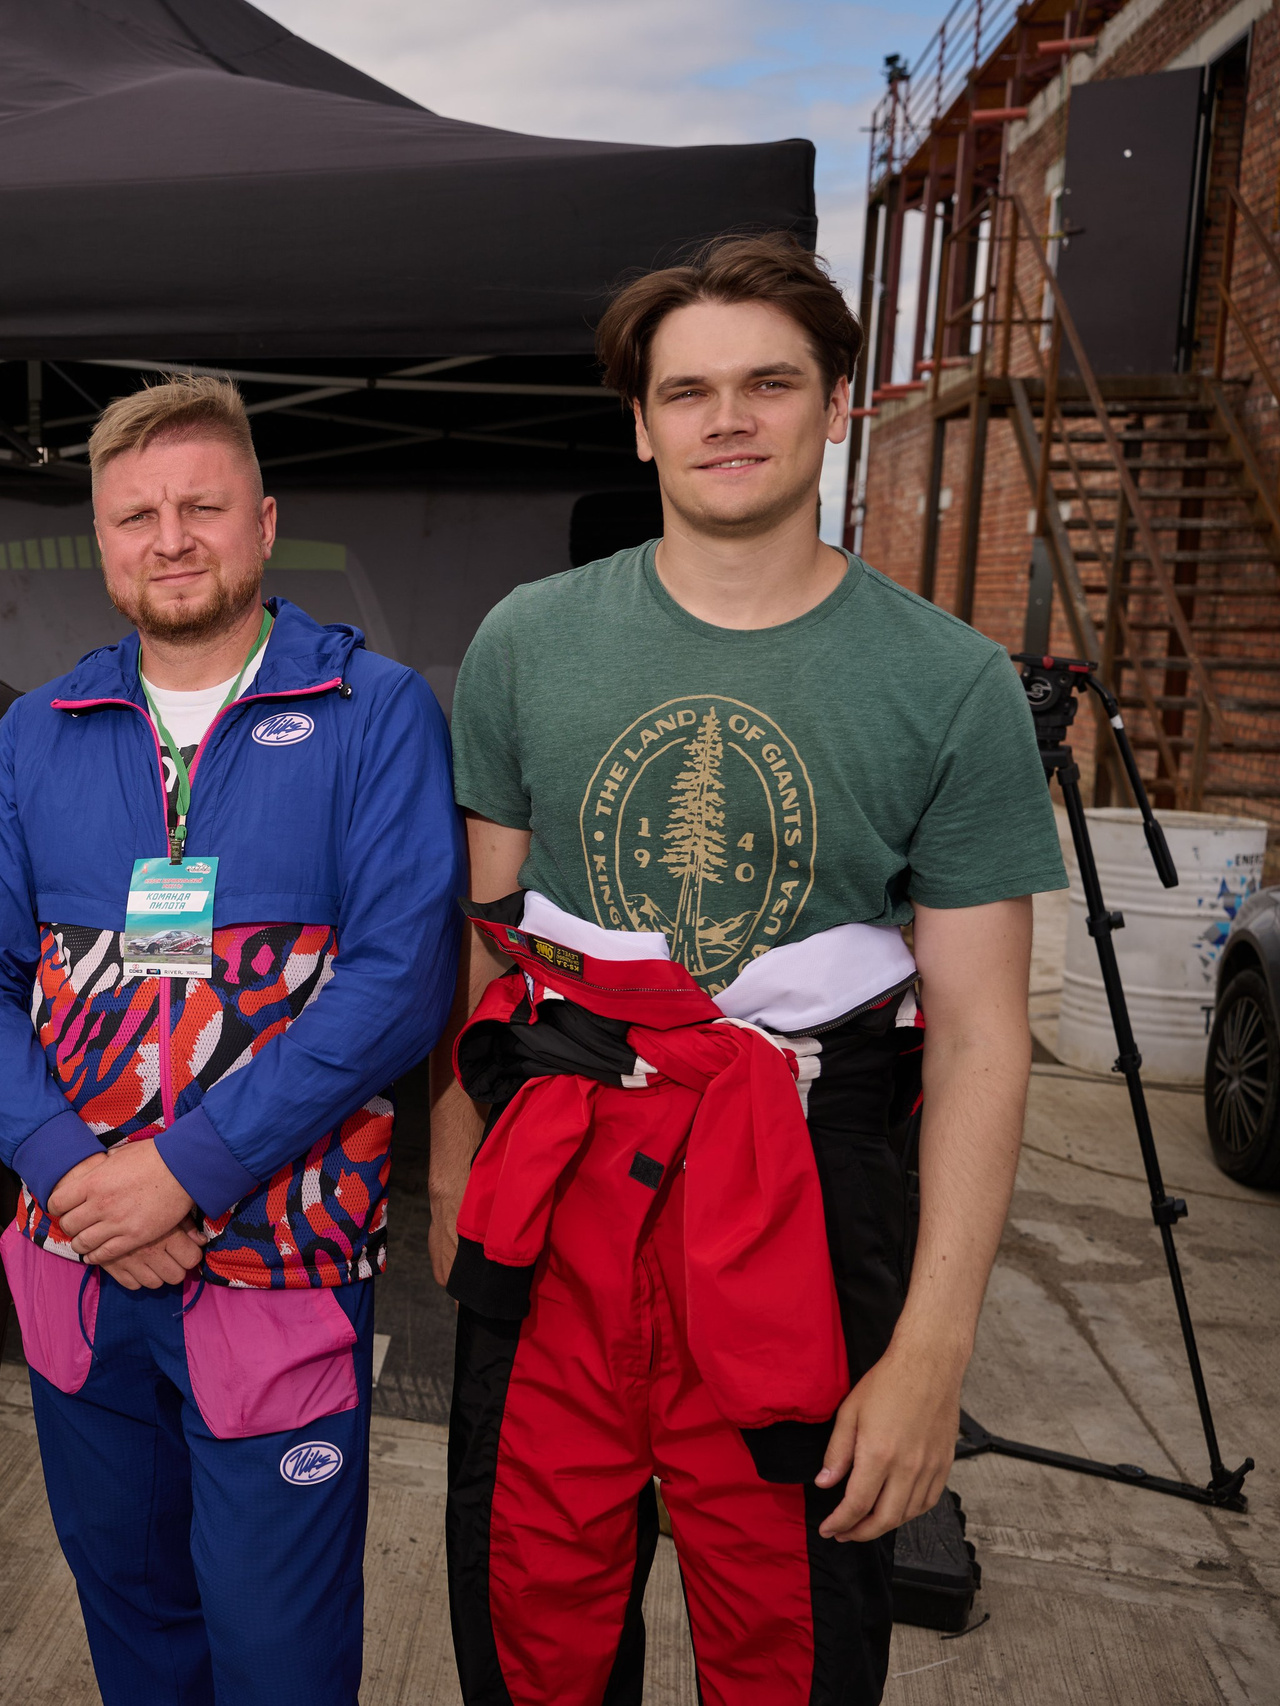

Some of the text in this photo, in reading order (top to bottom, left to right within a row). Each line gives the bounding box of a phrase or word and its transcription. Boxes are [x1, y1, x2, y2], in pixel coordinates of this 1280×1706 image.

[260, 715, 308, 739] Nike
[595, 709, 802, 846] THE LAND OF GIANTS
[146, 892, 191, 901] КОМАНДА
[149, 901, 186, 910] ПИЛОТА
[593, 854, 629, 931] KING
[763, 880, 799, 935] USA
[289, 1447, 338, 1478] Nike
